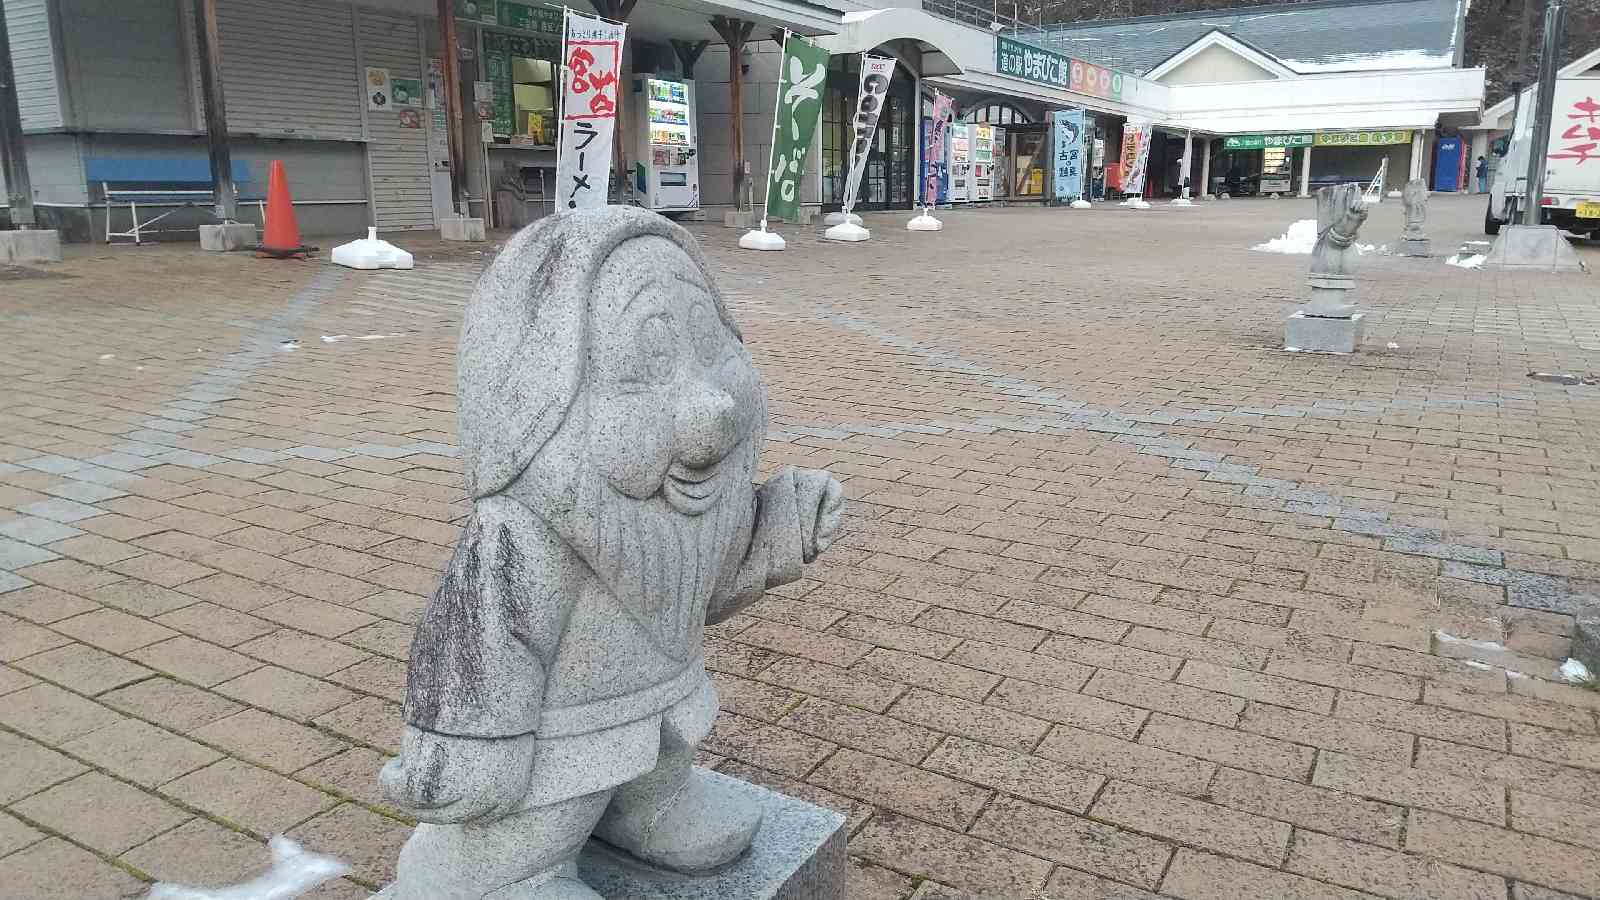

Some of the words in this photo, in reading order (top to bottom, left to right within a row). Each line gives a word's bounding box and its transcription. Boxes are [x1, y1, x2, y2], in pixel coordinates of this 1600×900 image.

[1001, 51, 1023, 76] 道の駅
[1024, 48, 1068, 86] やまびこ館
[569, 122, 598, 208] ラーメ
